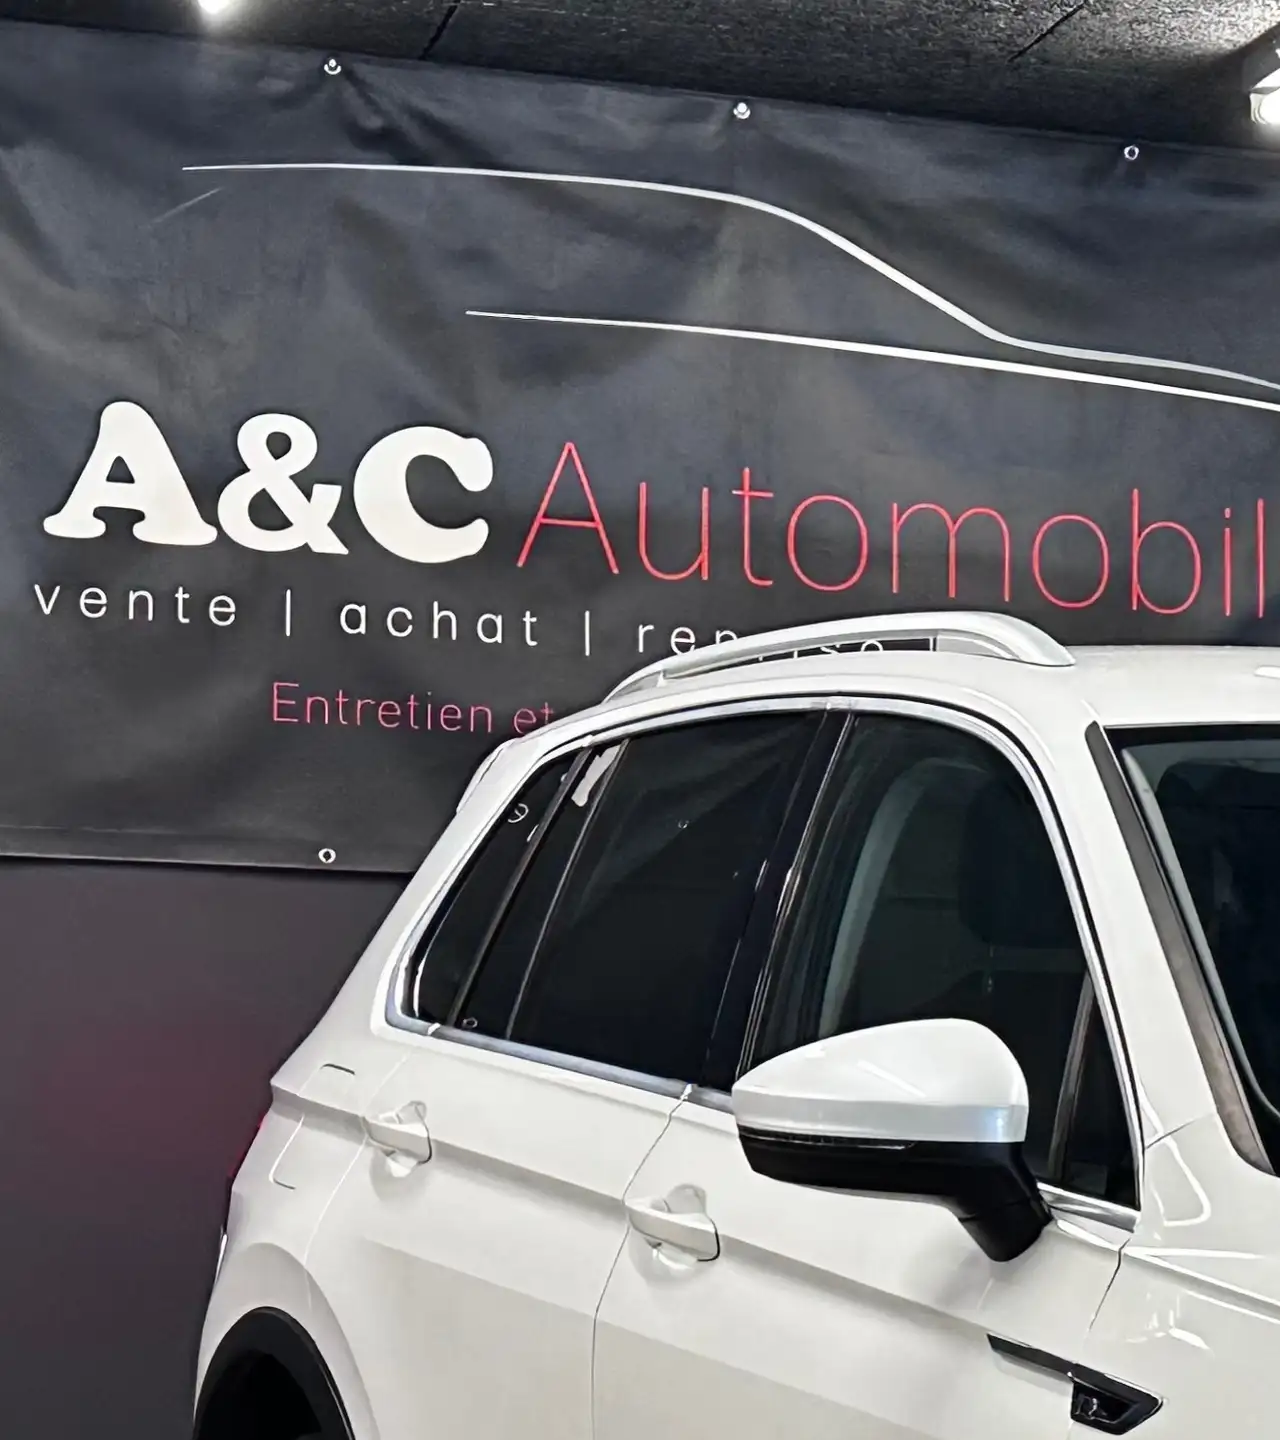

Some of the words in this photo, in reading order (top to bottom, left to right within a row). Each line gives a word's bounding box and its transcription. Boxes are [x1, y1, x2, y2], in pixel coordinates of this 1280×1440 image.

[43, 401, 493, 563] A&C
[35, 582, 237, 626] vente
[340, 601, 539, 646] achat
[273, 682, 491, 733] Entretien
[513, 702, 553, 734] et
